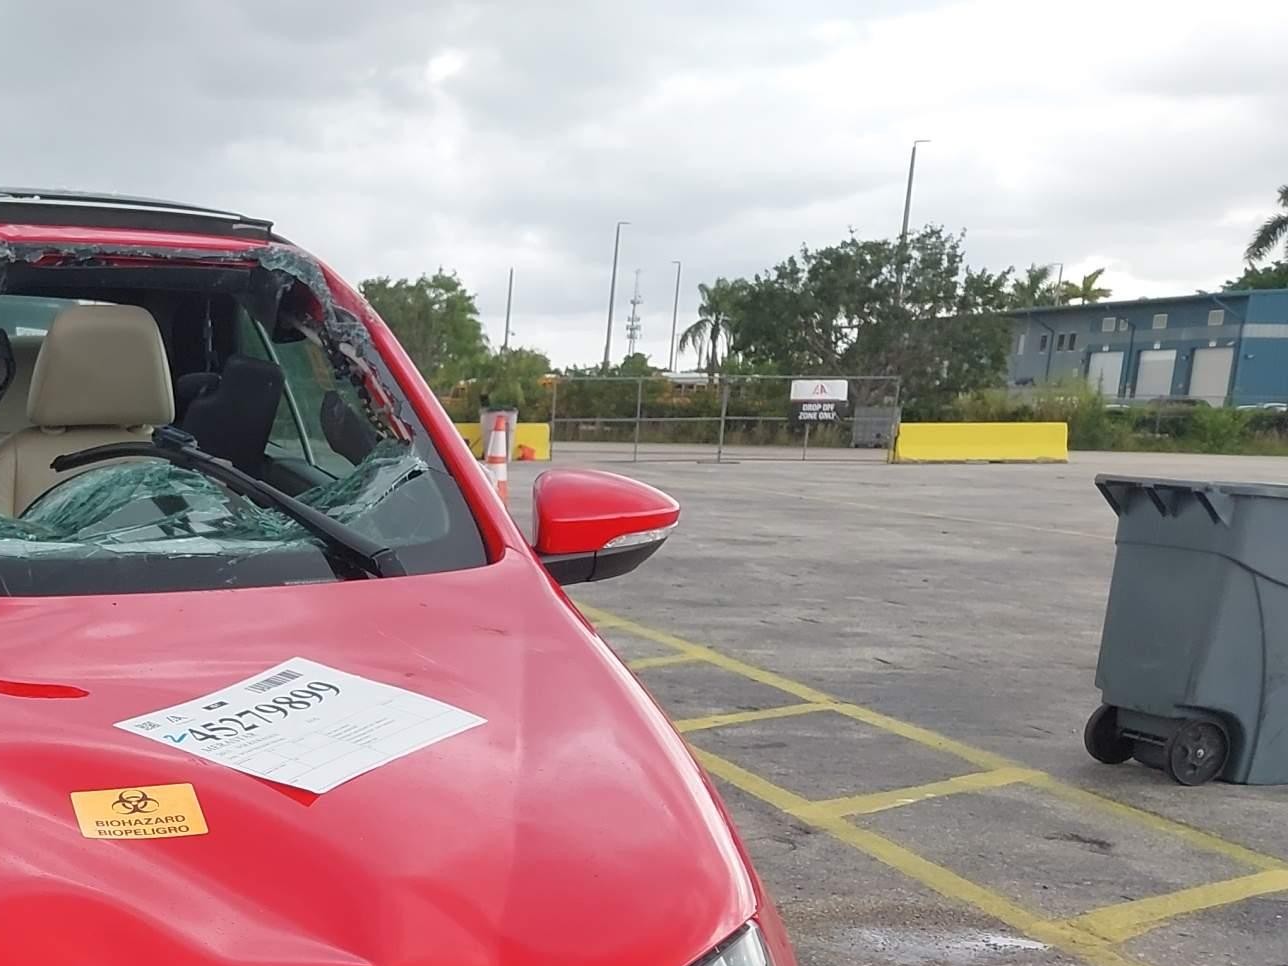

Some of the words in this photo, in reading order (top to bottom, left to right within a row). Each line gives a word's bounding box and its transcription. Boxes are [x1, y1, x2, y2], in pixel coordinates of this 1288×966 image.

[802, 403, 822, 411] DROP
[798, 411, 818, 420] ZONE
[818, 411, 837, 420] ONLY
[187, 680, 340, 742] 45279899
[95, 814, 186, 827] BIOHAZARD
[97, 825, 190, 837] BIOPELIGRO
